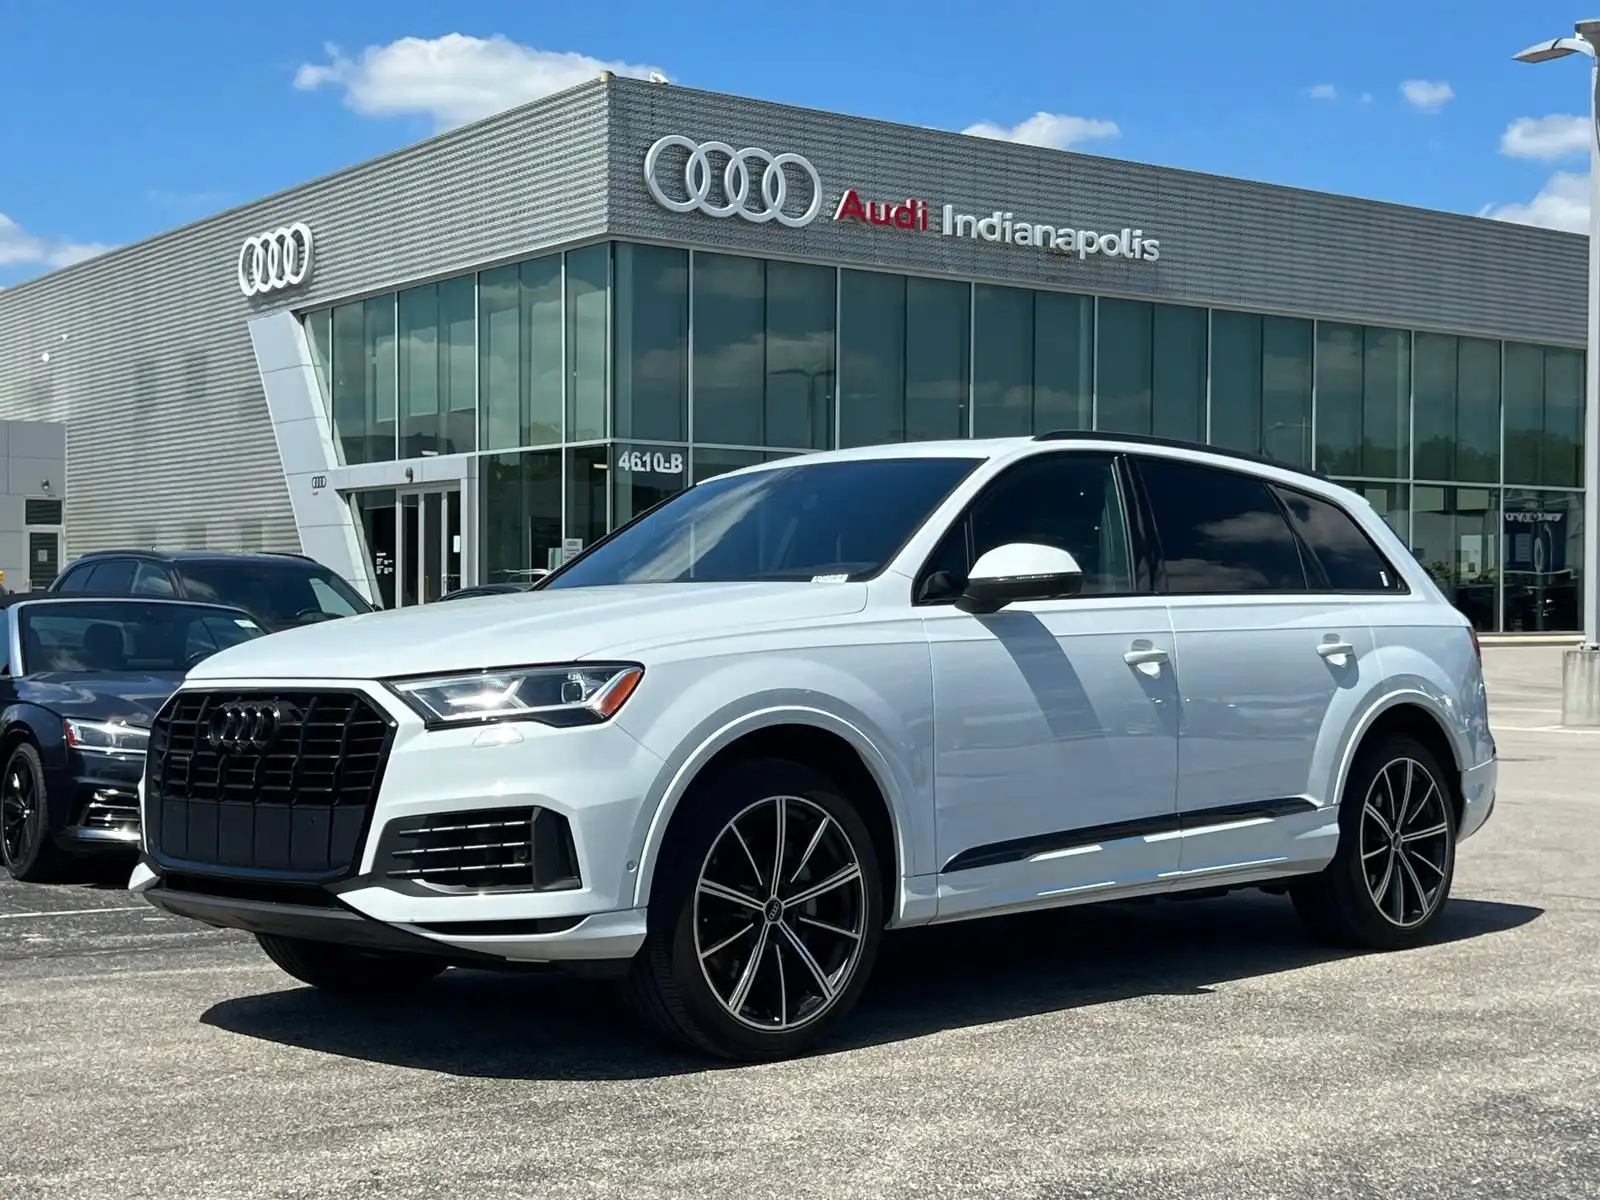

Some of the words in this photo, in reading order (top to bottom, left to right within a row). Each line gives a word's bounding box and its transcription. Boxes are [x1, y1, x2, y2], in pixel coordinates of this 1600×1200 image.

[833, 188, 928, 231] Audi
[942, 204, 1160, 261] Indianapolis
[618, 451, 683, 474] 4610-B
